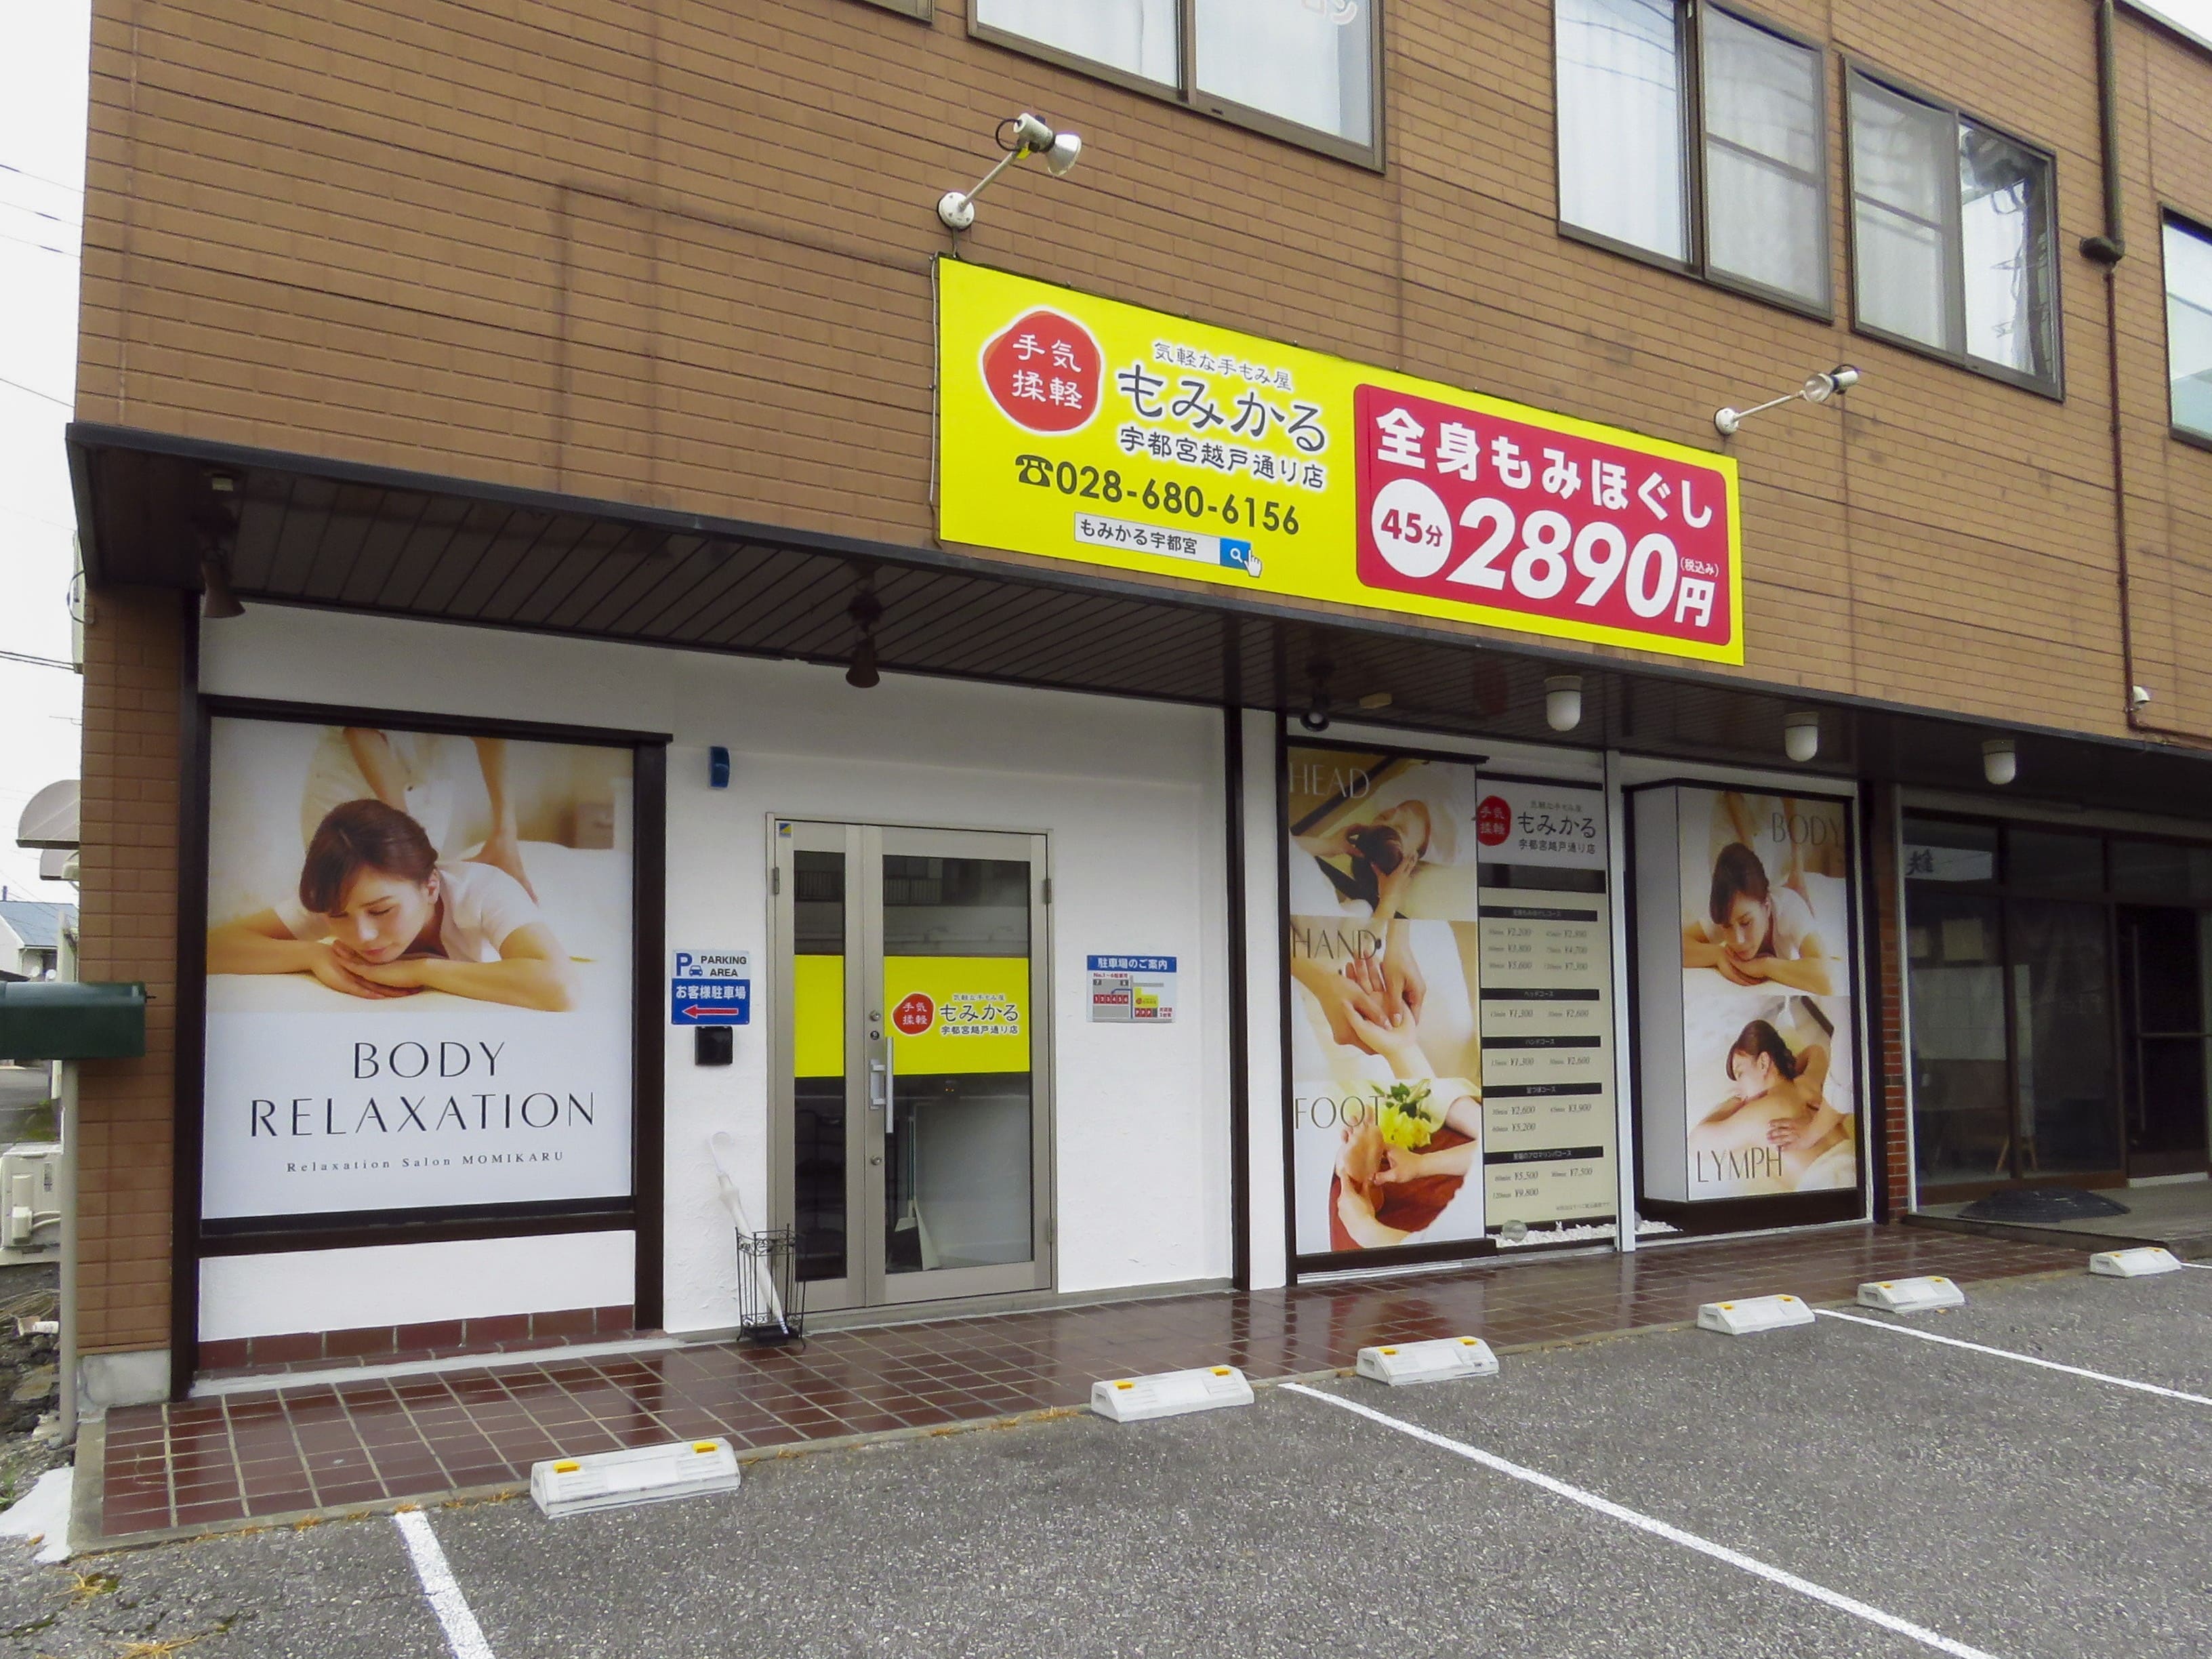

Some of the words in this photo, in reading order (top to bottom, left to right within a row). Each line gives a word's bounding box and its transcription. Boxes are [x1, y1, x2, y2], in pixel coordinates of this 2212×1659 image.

[1154, 342, 1292, 391] 気軽な手もみ屋
[1118, 363, 1326, 452] もみかる
[1120, 427, 1324, 489] 宇都宮越戸通り店
[1376, 407, 1713, 529] 全身もみほぐし
[1057, 461, 1299, 535] 028-680-6156
[1081, 518, 1197, 555] もみかる宇都宮
[1380, 509, 1443, 547] 45分
[1680, 557, 1719, 577] (税込み)
[1289, 762, 1370, 798] HEAD
[1517, 811, 1596, 838] もみかる
[1772, 813, 1843, 847] BODY
[1291, 927, 1378, 960] HAND
[676, 953, 693, 977] P
[701, 956, 747, 964] PARKING
[710, 968, 738, 977] AREA
[1097, 957, 1168, 970] 駐車場のご案内
[676, 985, 746, 1000] お客様駐車場
[939, 1004, 1019, 1022] もみかる
[941, 1025, 1018, 1035] 宇都宮越戸通り店
[354, 1041, 506, 1079] BODY
[250, 1092, 595, 1137] RELAXATION
[1294, 1095, 1384, 1130] FOOT
[287, 1158, 390, 1172] Relaxation
[402, 1155, 451, 1168] Salon
[462, 1151, 565, 1165] MOMIKARU
[1697, 1145, 1784, 1183] LYMPH
